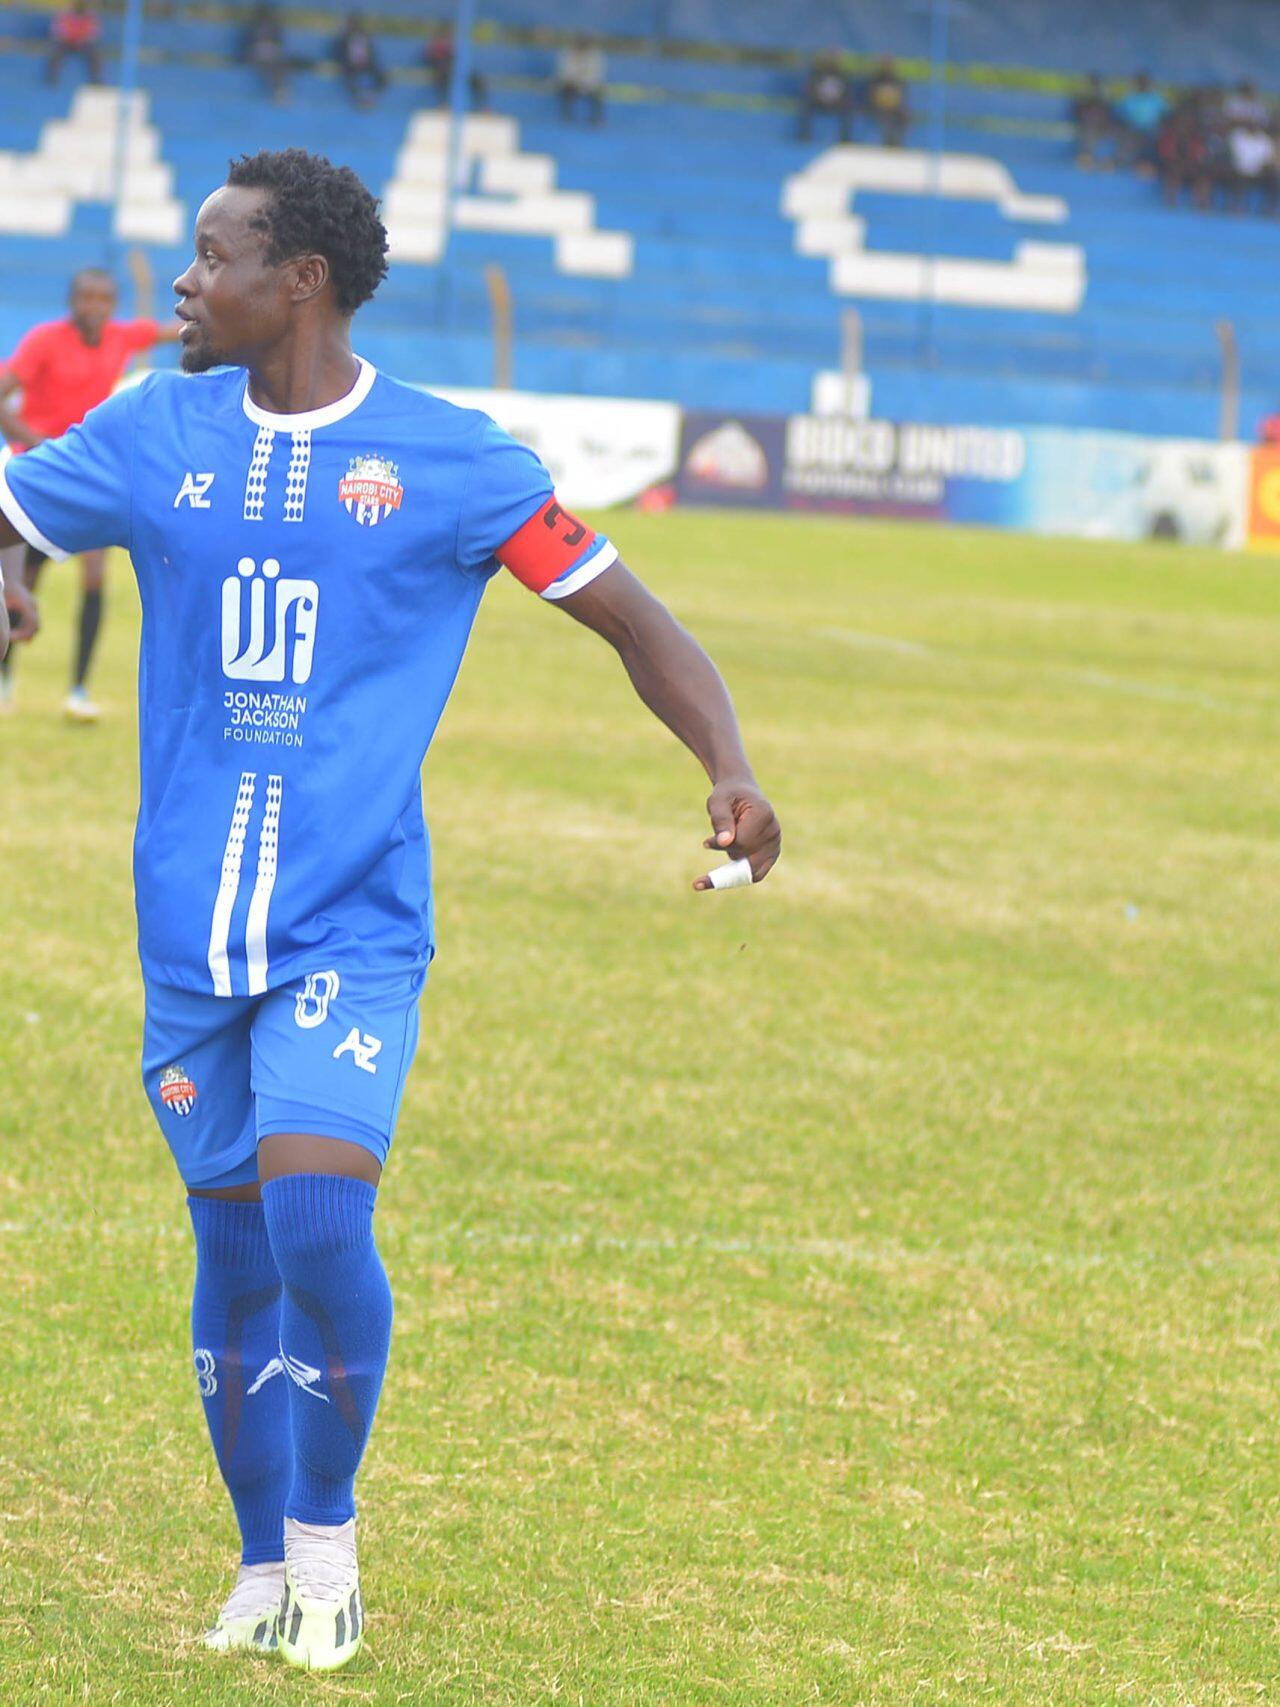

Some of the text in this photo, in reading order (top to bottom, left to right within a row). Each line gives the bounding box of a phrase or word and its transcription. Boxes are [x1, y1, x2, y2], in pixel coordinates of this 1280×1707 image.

[173, 472, 215, 509] AZ
[341, 482, 399, 502] NAIROBI CITY
[223, 691, 307, 714] JONATHAN
[230, 708, 300, 730] JACKSON
[223, 727, 304, 748] FOUNDATION
[332, 1026, 382, 1075] AZ
[193, 1348, 218, 1397] 8
